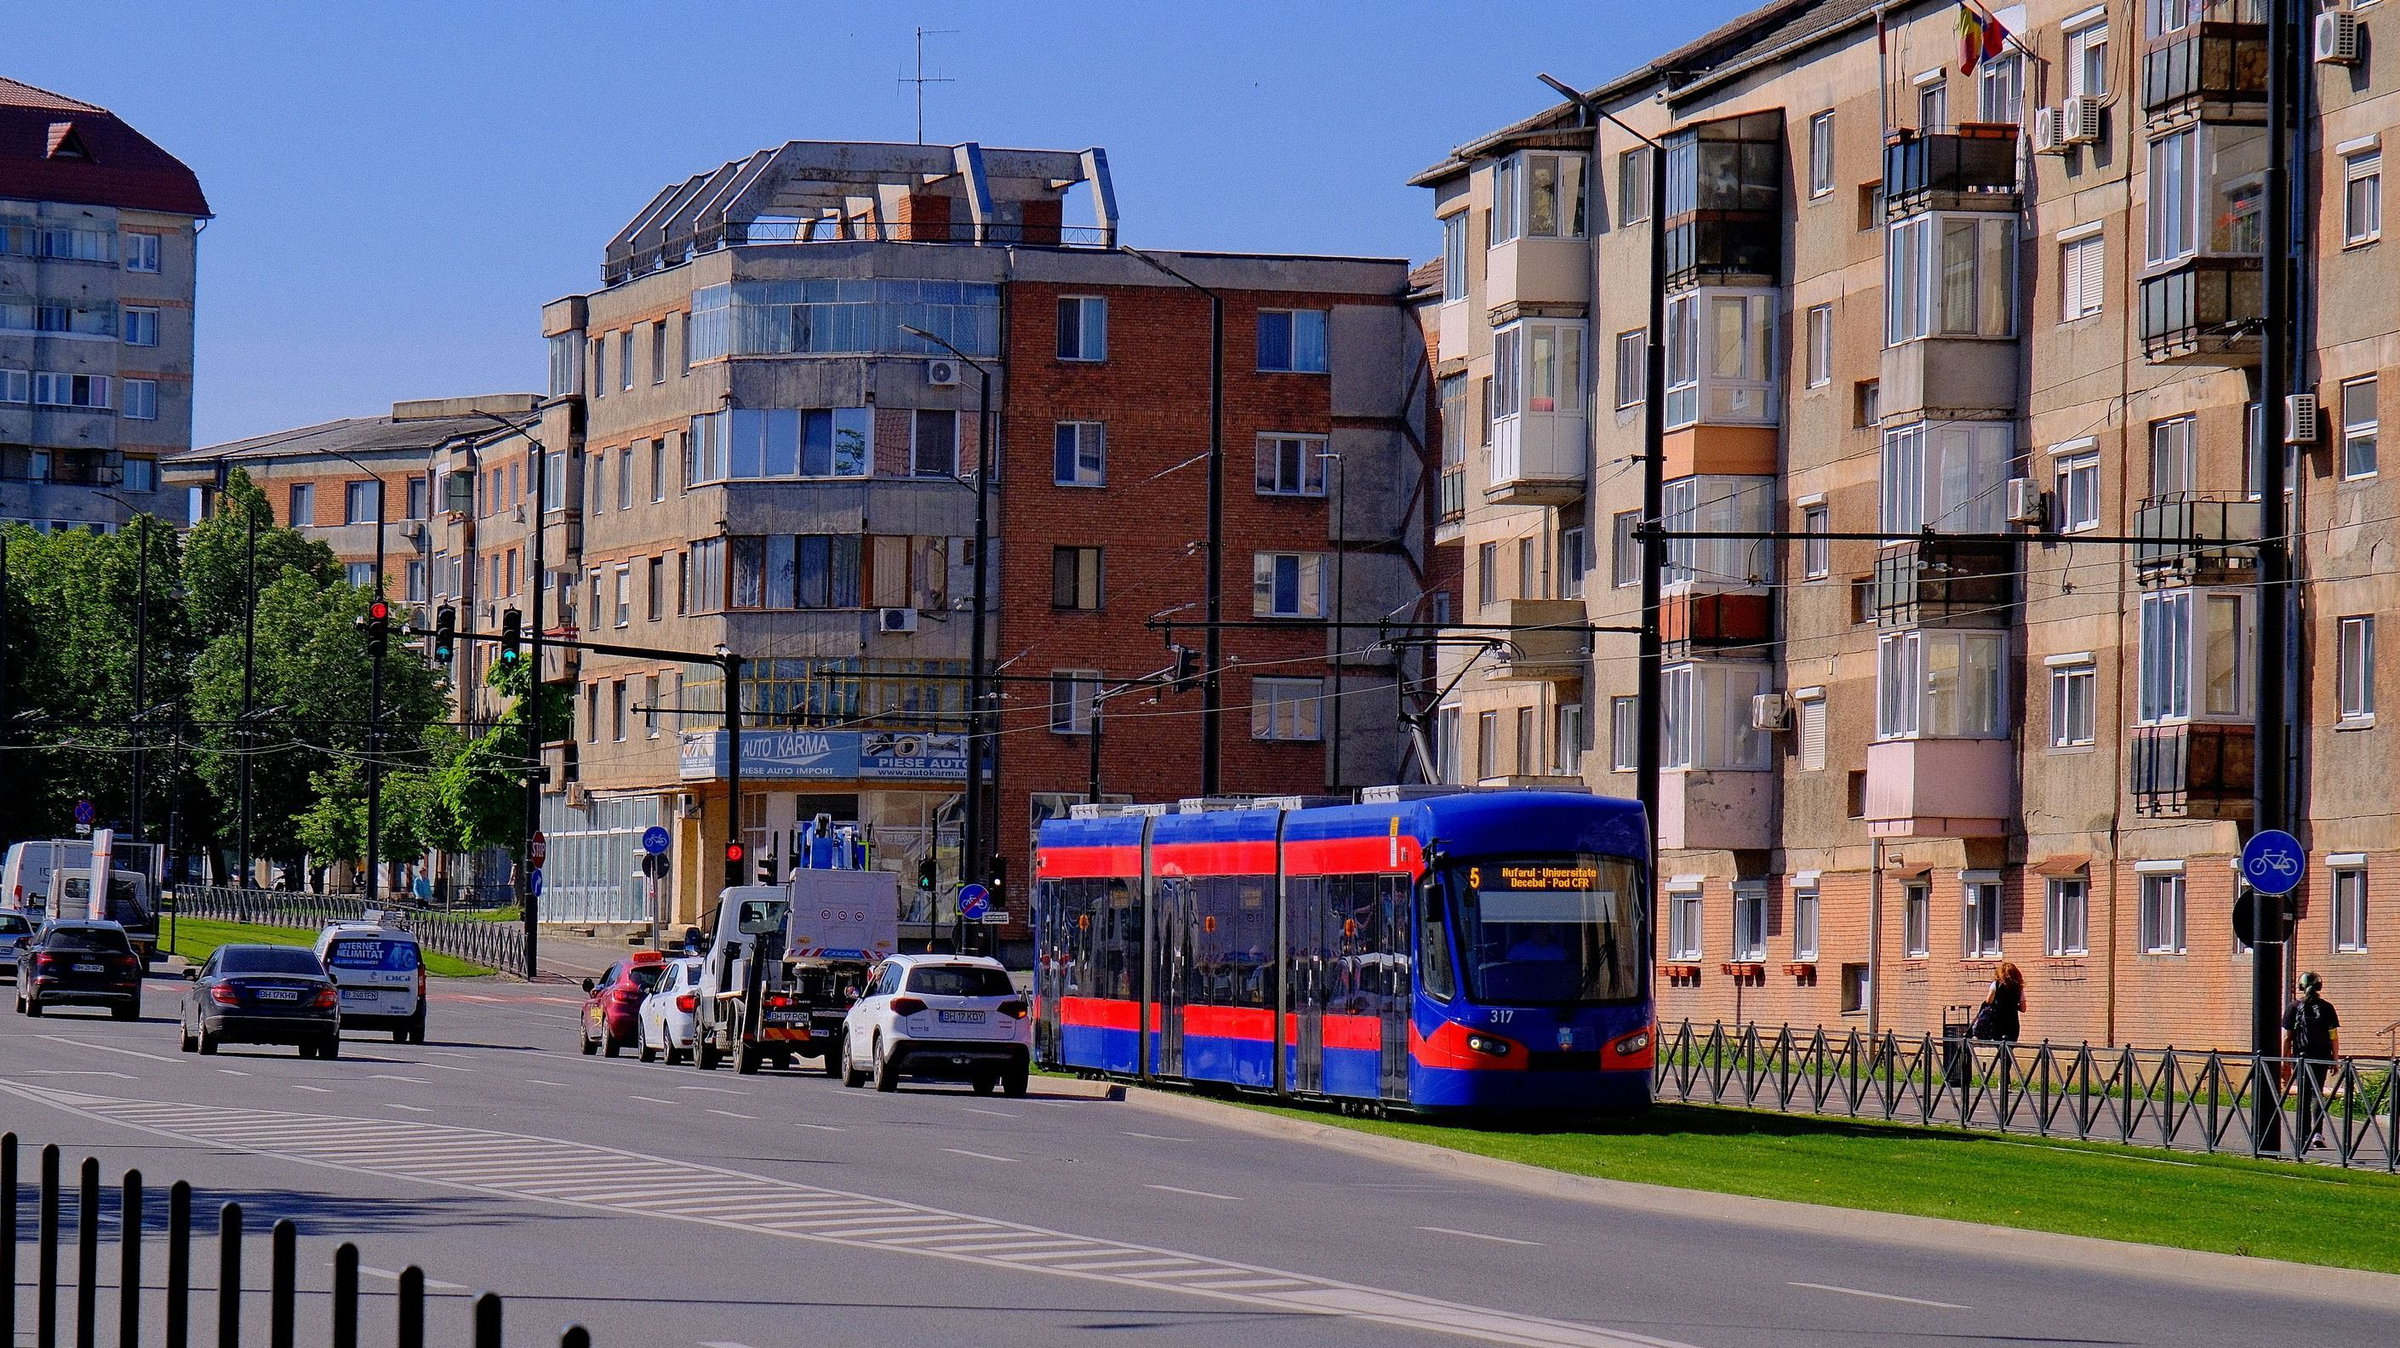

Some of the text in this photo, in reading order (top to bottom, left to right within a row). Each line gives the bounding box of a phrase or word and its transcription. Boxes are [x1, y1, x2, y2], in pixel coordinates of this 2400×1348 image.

[742, 735, 830, 757] AUTO KARMA
[879, 758, 924, 768] PIESE
[740, 767, 833, 775] PIESE AUTO IMPORT
[532, 842, 545, 857] STOP
[1502, 867, 1535, 877] Nufarul
[1542, 867, 1597, 877] Universitate
[1470, 867, 1480, 888] 5
[1511, 878, 1546, 887] Decebal
[1552, 878, 1570, 887] Pod
[1571, 878, 1589, 887] CFR
[339, 942, 382, 950] INTERNET
[336, 949, 385, 959] NELIMITAT
[772, 1012, 782, 1020] BH
[784, 1012, 791, 1020] 17
[945, 1012, 983, 1021] BH 17 KDY
[1490, 1010, 1513, 1023] 317
